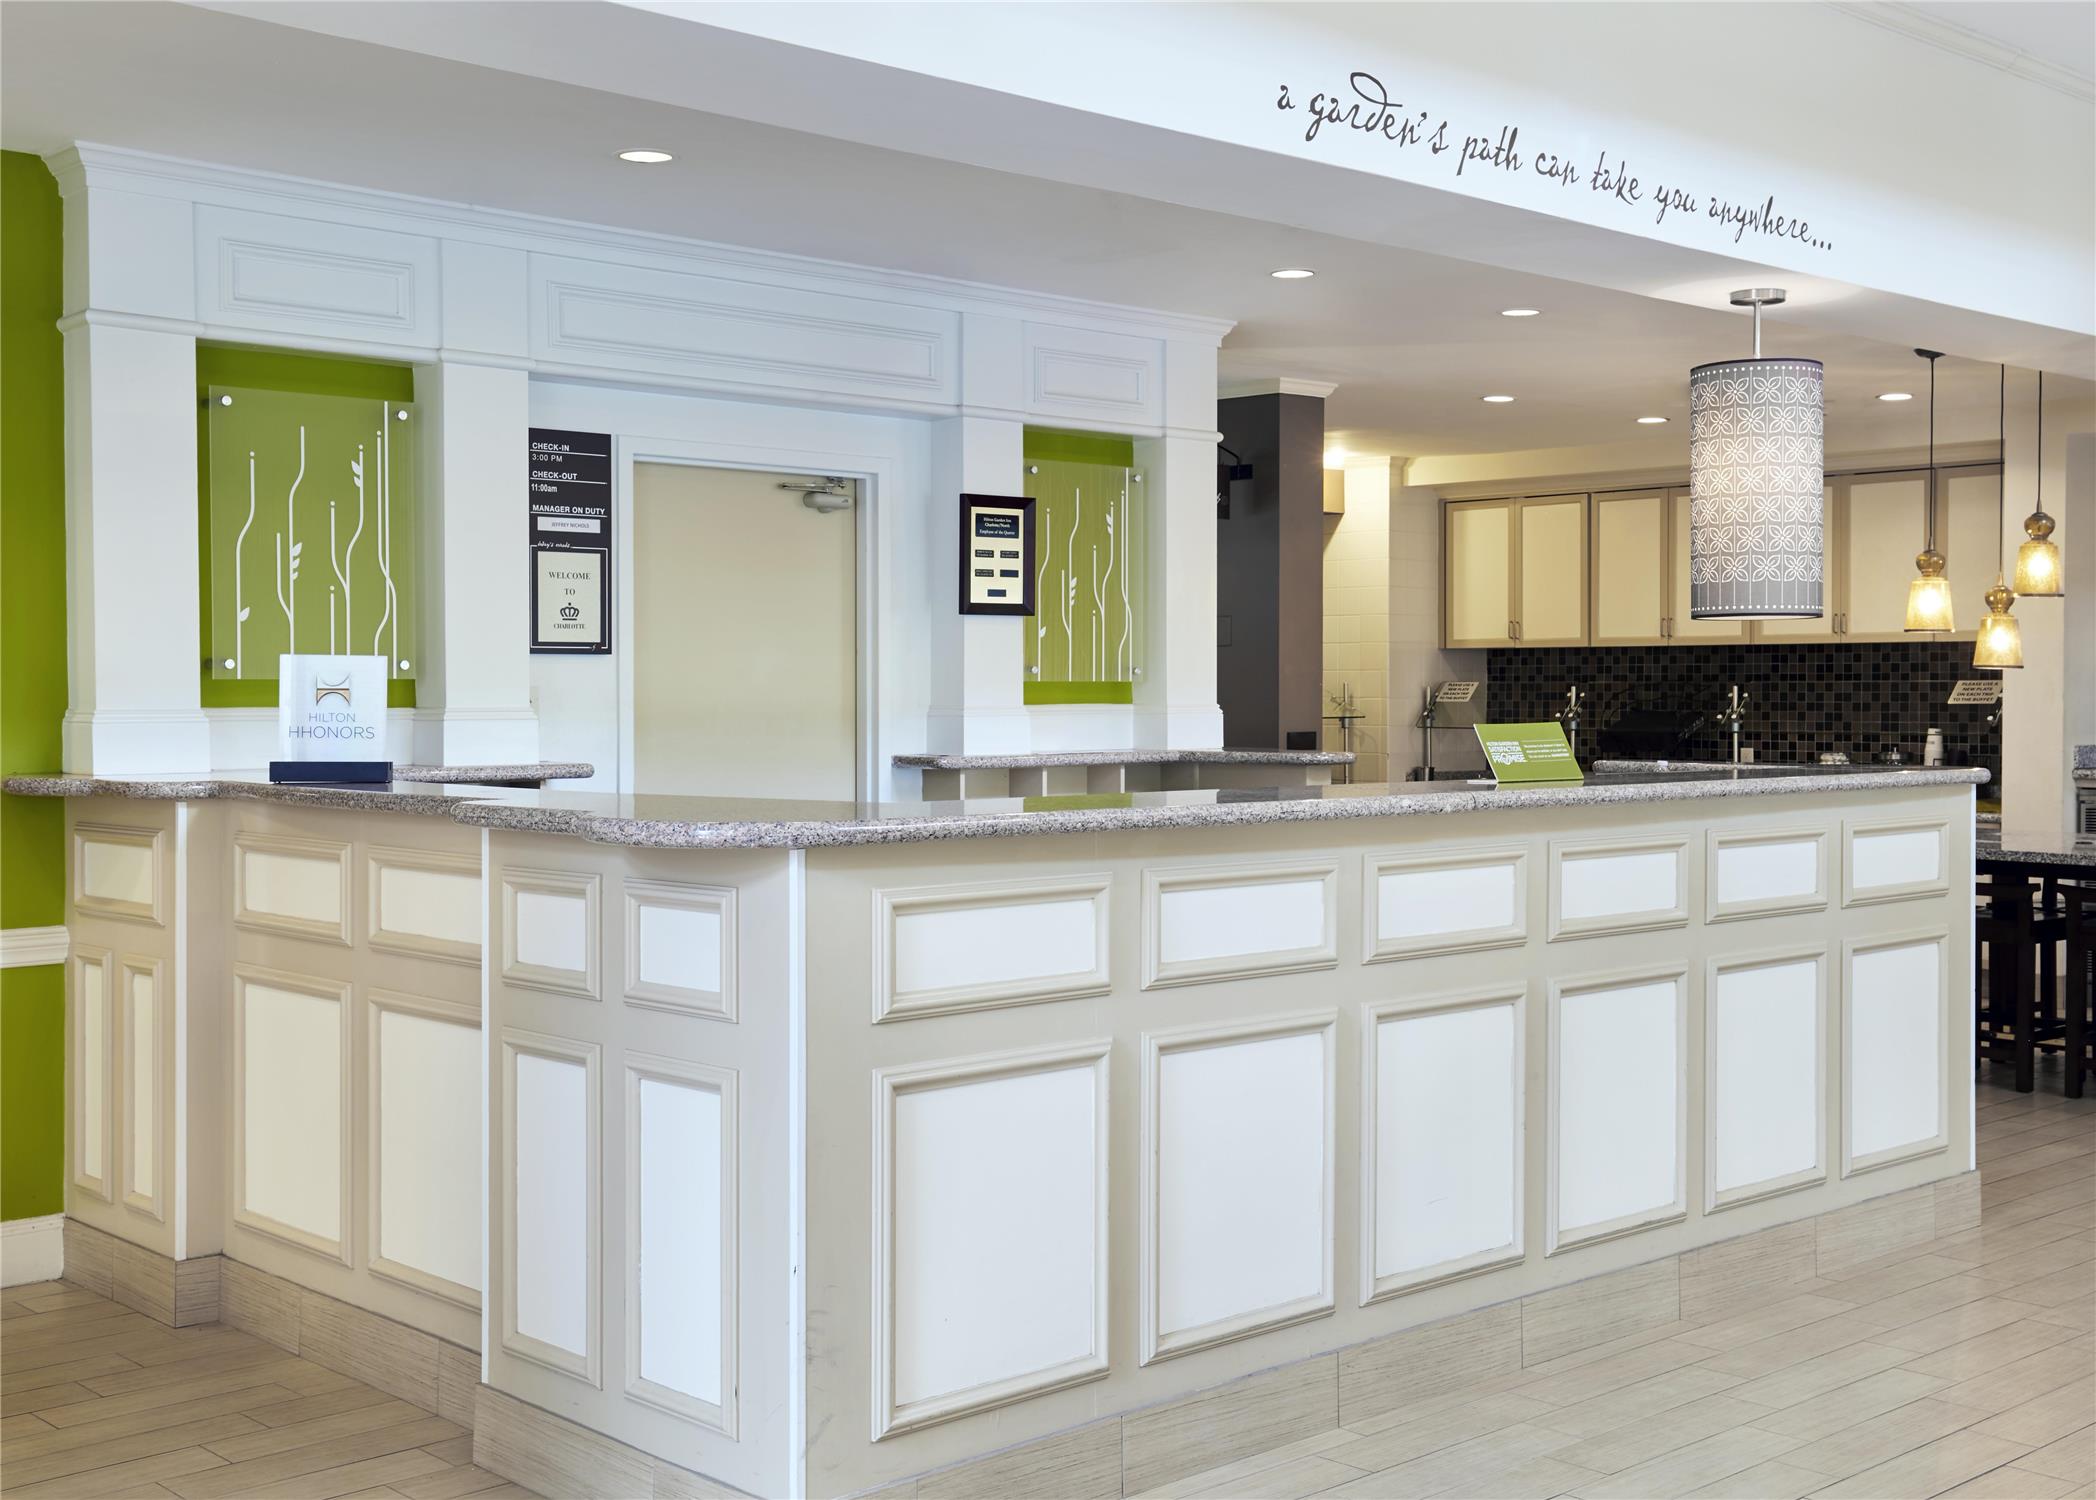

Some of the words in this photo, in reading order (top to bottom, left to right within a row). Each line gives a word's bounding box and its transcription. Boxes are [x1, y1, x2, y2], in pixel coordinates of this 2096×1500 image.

[1277, 84, 1296, 110] a
[1305, 72, 1449, 154] garden's
[1456, 125, 1524, 176] path
[1535, 152, 1580, 186] can
[1590, 151, 1643, 205] take
[1654, 185, 1698, 225] you
[1708, 195, 1832, 251] anywhere...
[532, 442, 570, 452] CHECK-IN
[532, 453, 549, 462] 3:00
[551, 454, 563, 463] PM
[532, 470, 578, 480] CHECK-OUT
[531, 483, 558, 493] 11:00am
[532, 504, 570, 513] MANAGER
[572, 506, 583, 514] ON
[585, 507, 605, 515] DUTY
[549, 571, 591, 580] WELCOME
[564, 588, 576, 596] TO
[309, 712, 356, 723] HILTON
[289, 726, 375, 739] HHONORS
